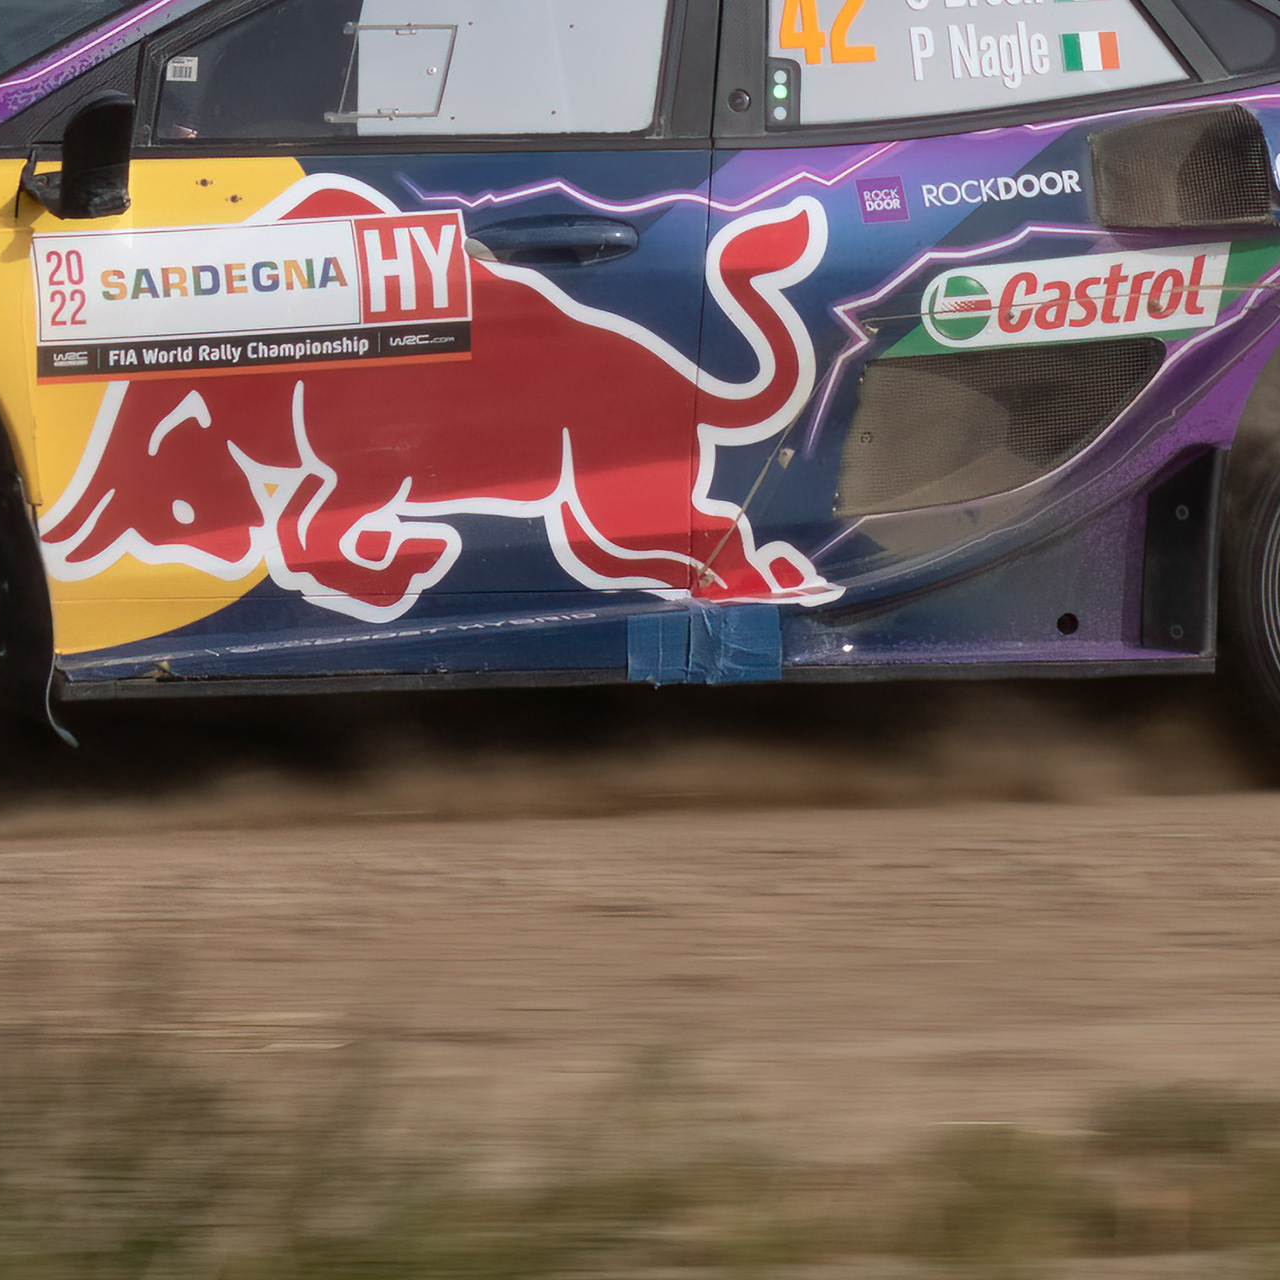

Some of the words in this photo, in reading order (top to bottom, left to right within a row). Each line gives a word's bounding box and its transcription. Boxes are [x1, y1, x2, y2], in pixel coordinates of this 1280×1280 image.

[908, 25, 935, 81] P
[948, 20, 1051, 89] Nagle
[863, 187, 900, 202] ROCK
[866, 198, 902, 212] DOOR
[922, 169, 1082, 208] ROCKDOOR
[45, 248, 85, 288] 20
[100, 256, 349, 302] SARDEGNA
[363, 223, 457, 314] HY
[49, 288, 88, 328] 22
[997, 253, 1207, 334] Castrol
[53, 351, 89, 362] WRC
[108, 348, 138, 367] FIA
[142, 345, 194, 366] World
[198, 343, 242, 365] Rally
[246, 336, 370, 361] Championship
